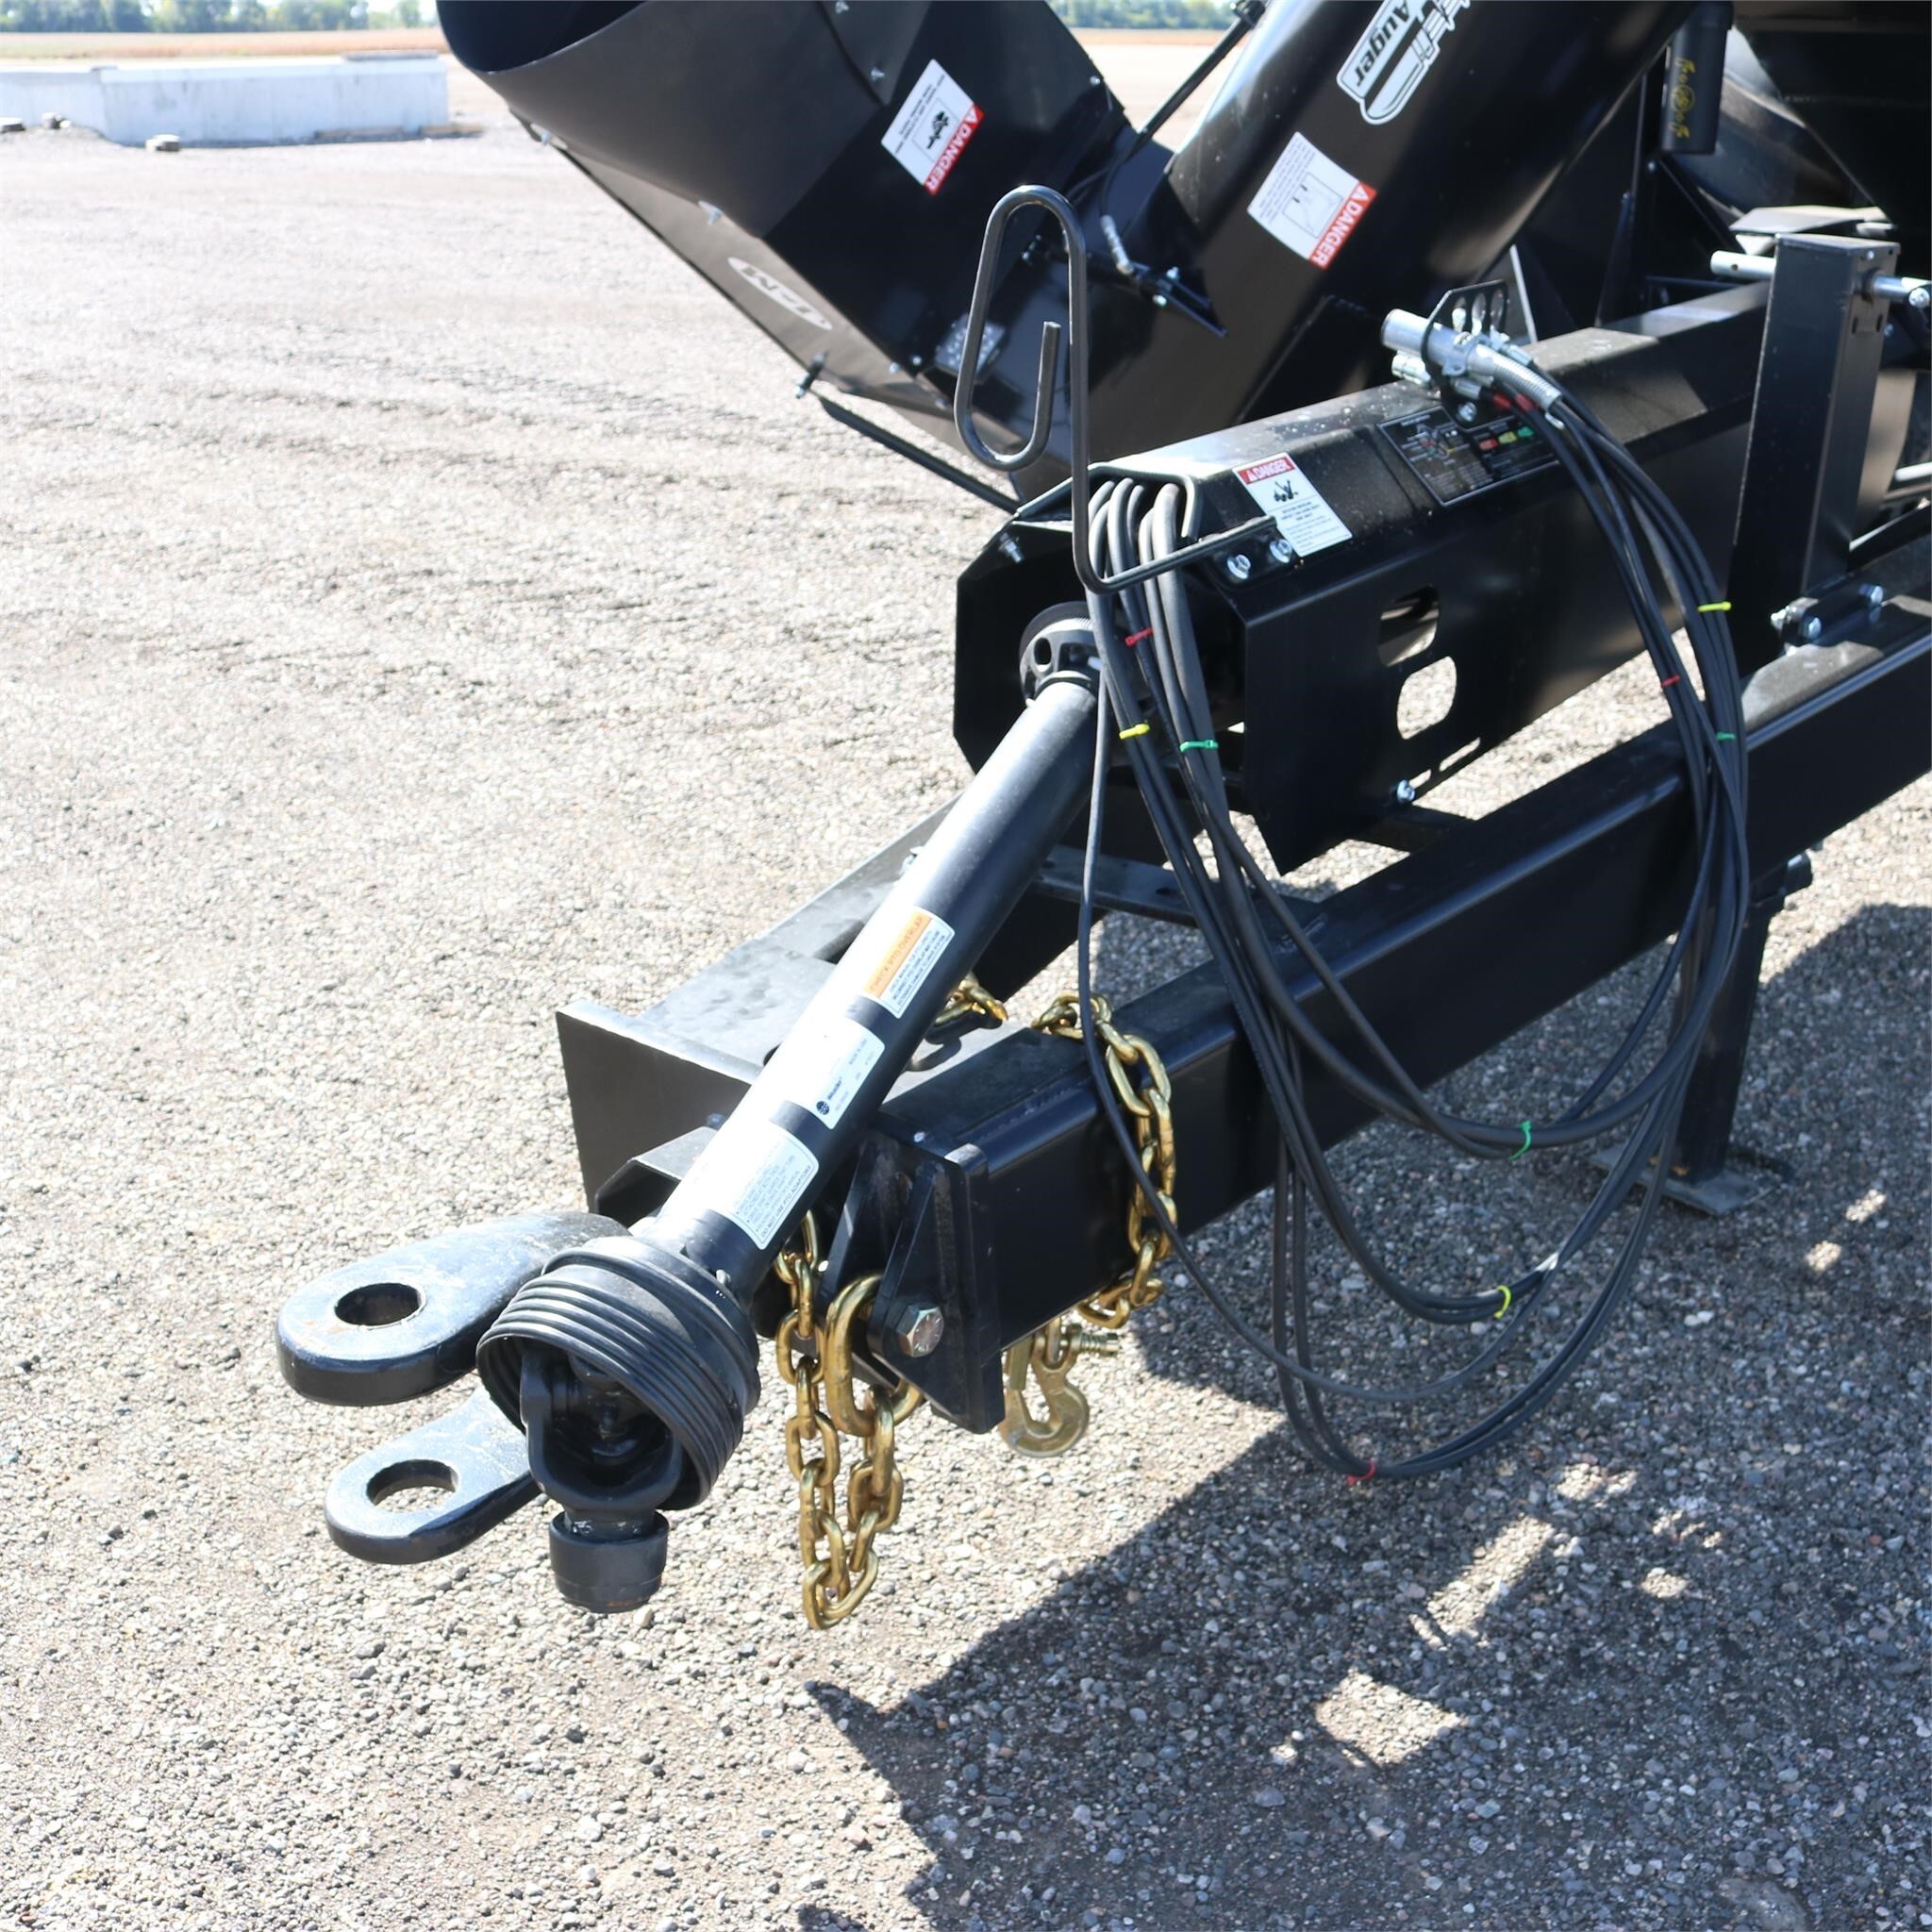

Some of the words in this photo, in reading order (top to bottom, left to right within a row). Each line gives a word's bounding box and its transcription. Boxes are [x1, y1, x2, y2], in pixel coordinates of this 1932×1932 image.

[1354, 0, 1411, 87] Auger
[925, 124, 972, 189] DANGER
[1312, 202, 1363, 264] DANGER
[1253, 459, 1291, 478] DANGER
[899, 914, 924, 949] OVERLAP
